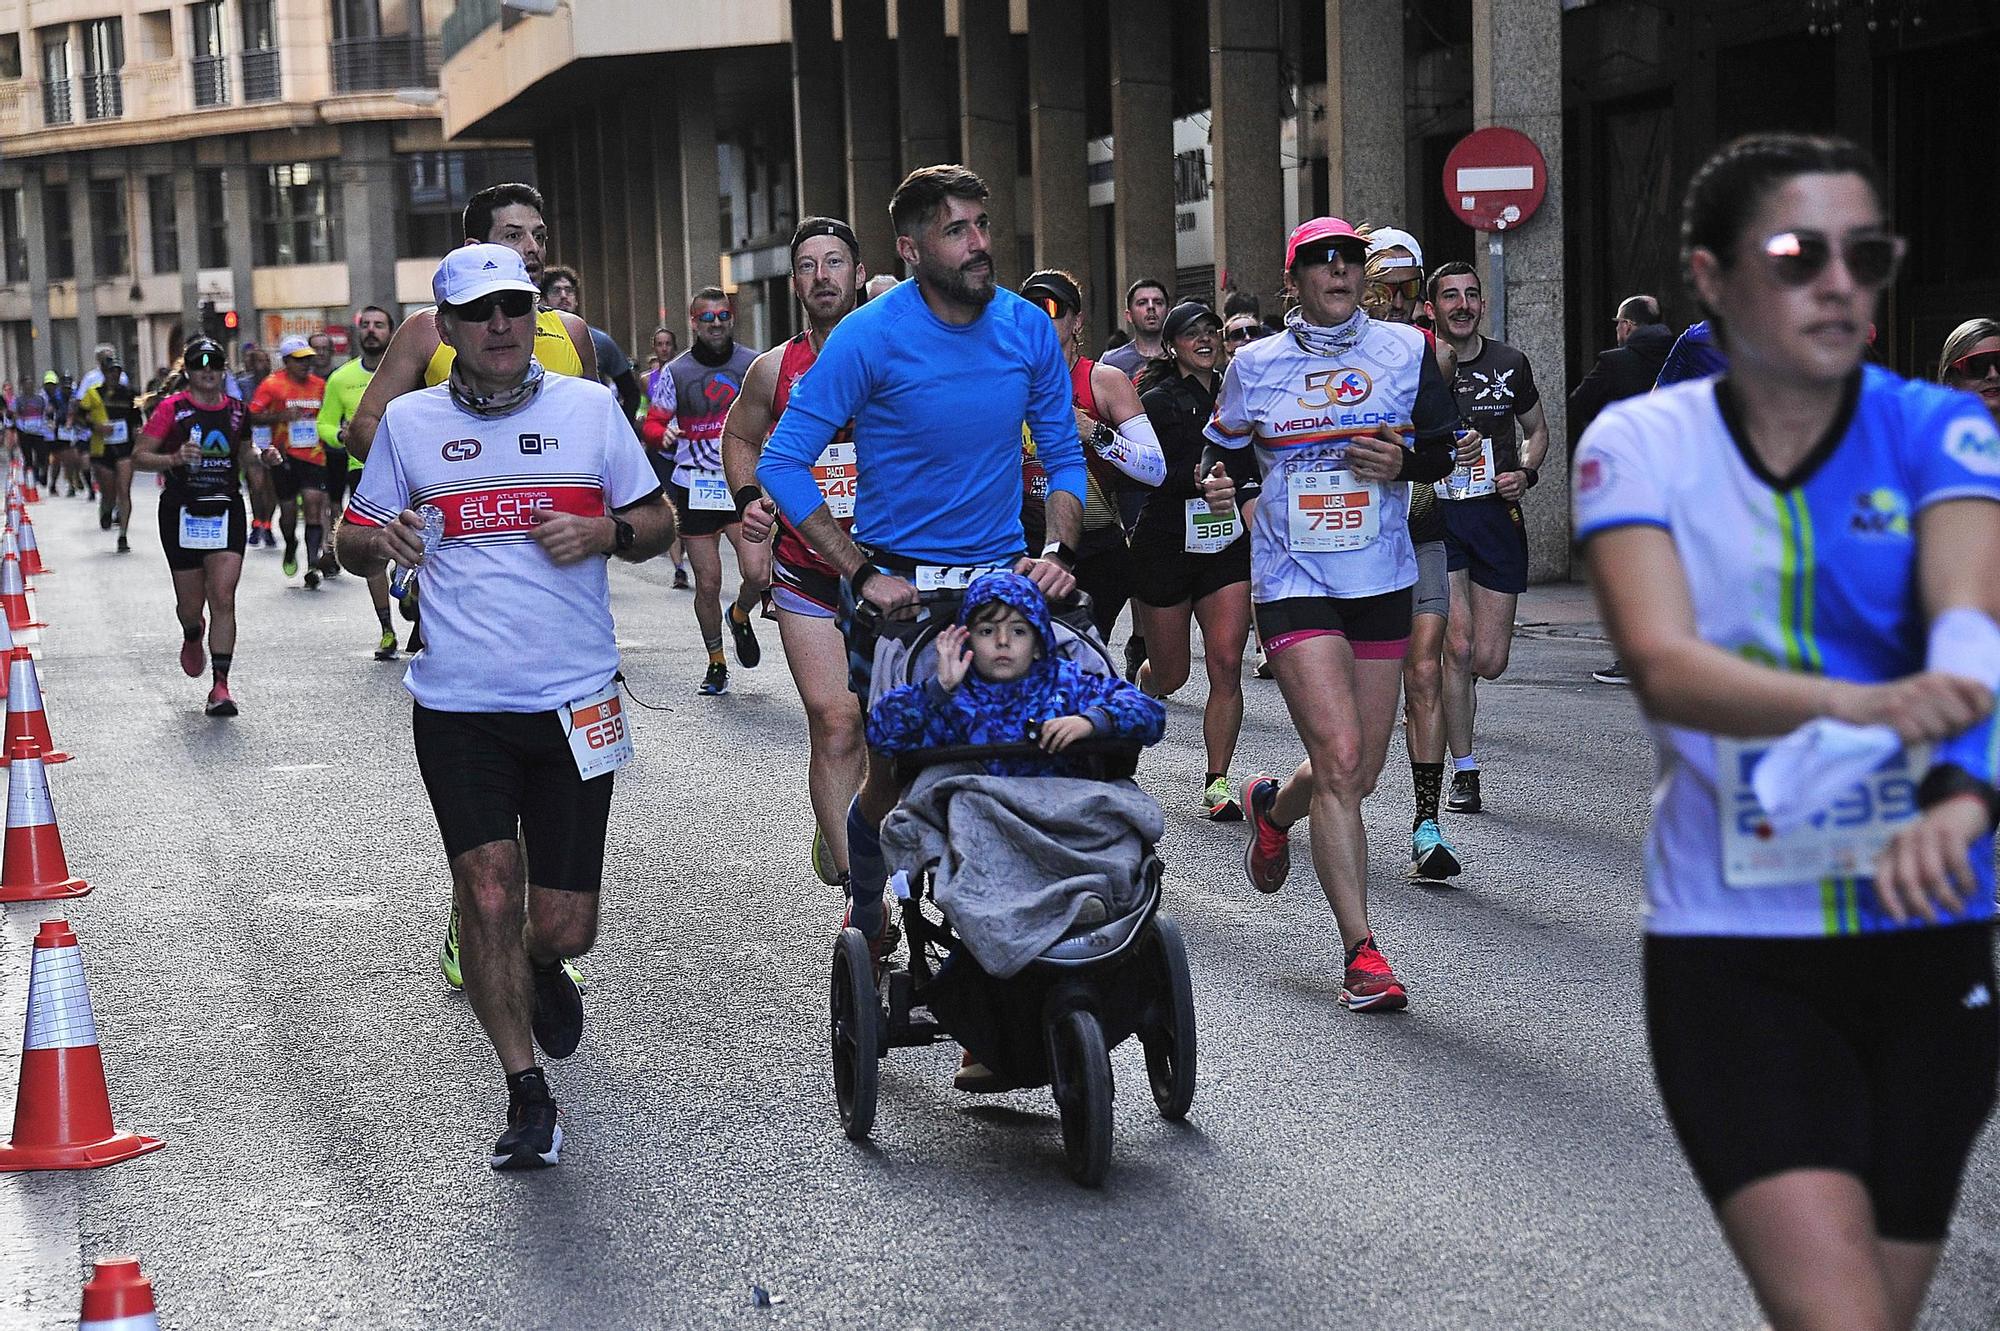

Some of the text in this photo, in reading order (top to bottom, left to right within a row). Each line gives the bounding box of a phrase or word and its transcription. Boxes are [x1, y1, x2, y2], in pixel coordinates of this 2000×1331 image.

[1274, 413, 1396, 433] MEDIA ELCHE
[826, 466, 845, 478] PACO
[464, 491, 547, 503] CLUB ATLETISMO
[699, 488, 727, 500] 1751
[1323, 496, 1346, 508] LUISA
[460, 498, 553, 519] ELCHE
[461, 516, 542, 531] DECATLO
[1306, 510, 1363, 531] 739
[1197, 522, 1234, 539] 398
[586, 717, 624, 750] 639
